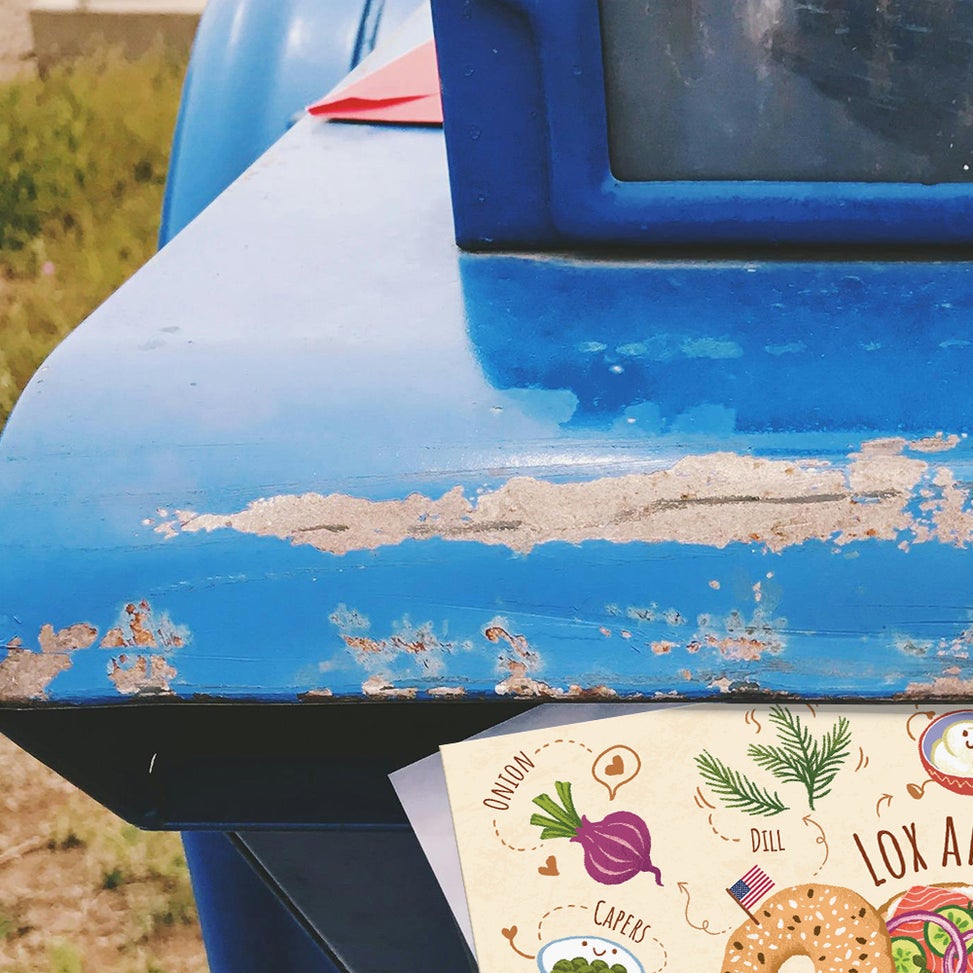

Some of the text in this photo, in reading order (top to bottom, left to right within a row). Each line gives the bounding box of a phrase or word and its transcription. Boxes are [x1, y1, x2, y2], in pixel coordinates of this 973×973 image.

[482, 750, 535, 811] ONION
[750, 827, 786, 853] DILL
[852, 821, 928, 888] LOX
[593, 900, 652, 944] CAPERS
